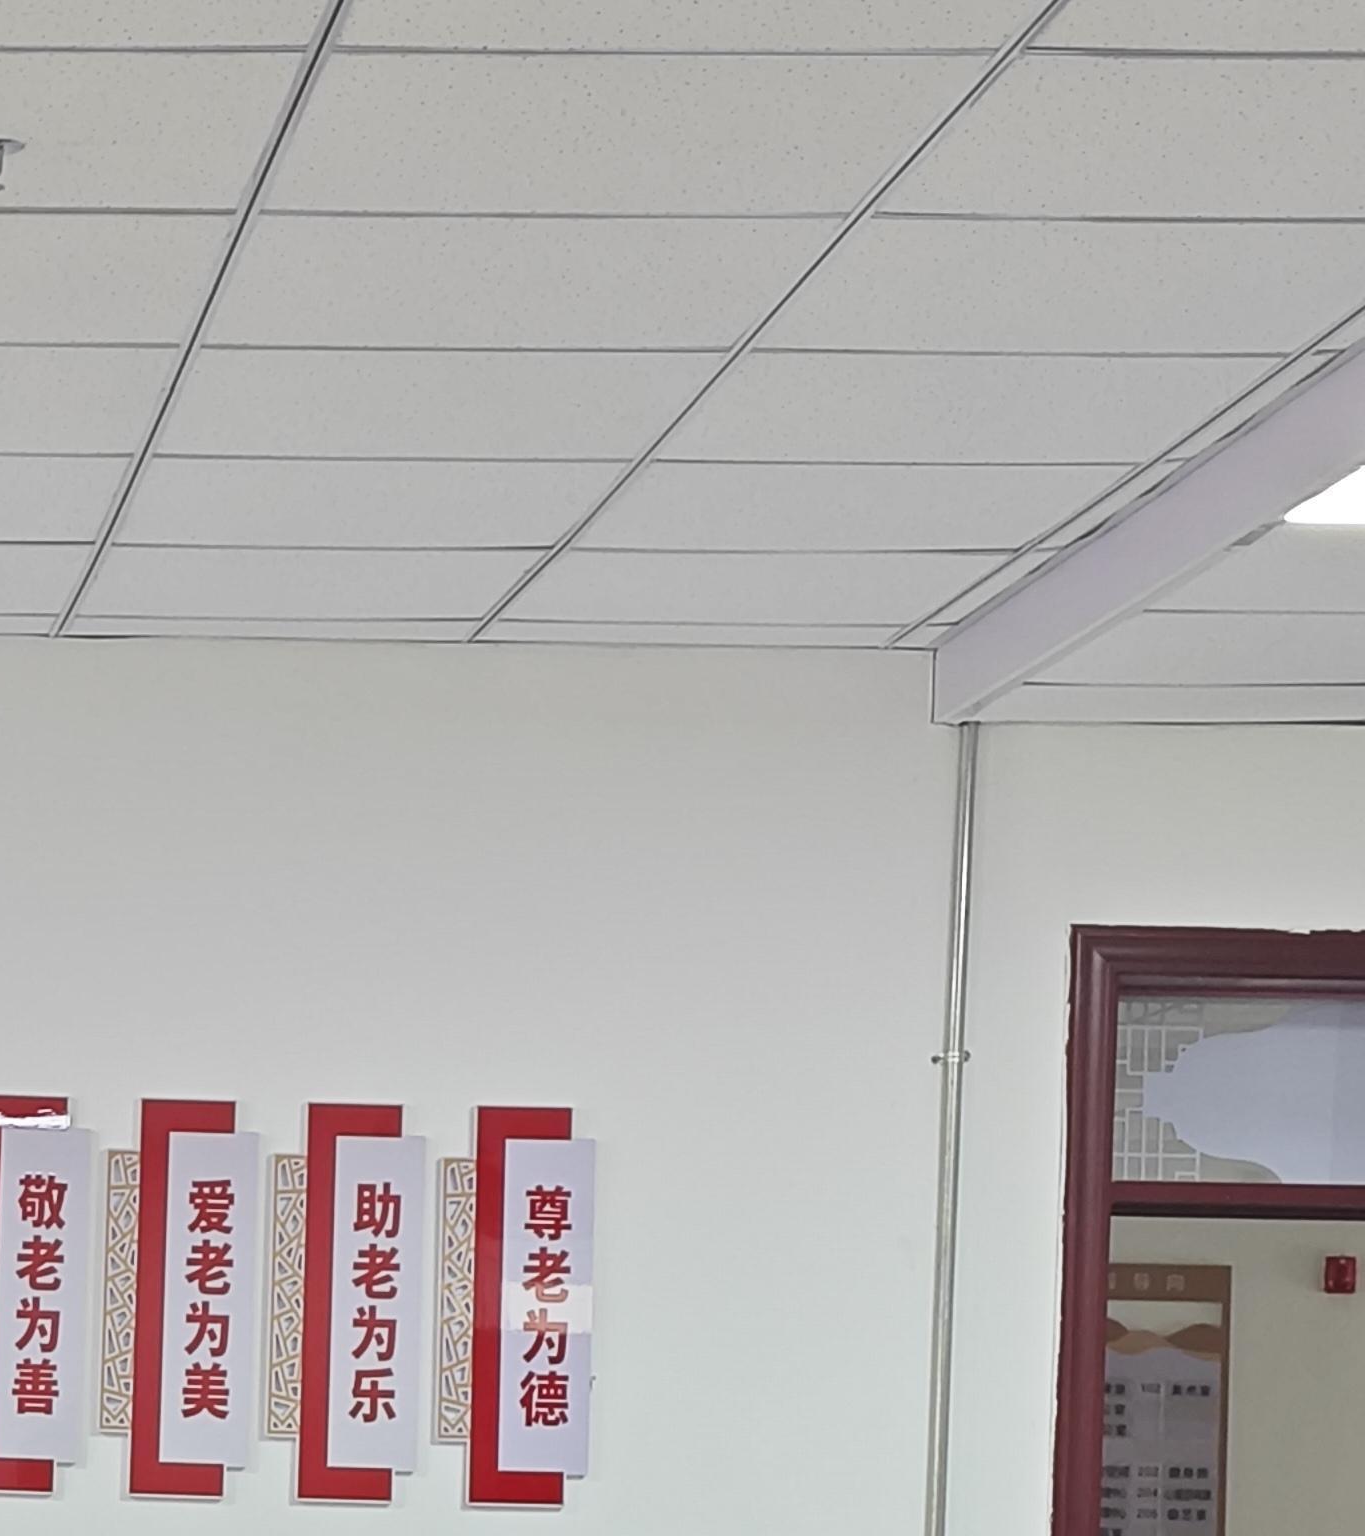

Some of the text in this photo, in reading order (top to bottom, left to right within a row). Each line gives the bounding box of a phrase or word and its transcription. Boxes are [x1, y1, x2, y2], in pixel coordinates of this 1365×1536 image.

[11, 1174, 68, 1416] 敬老为善
[181, 1178, 235, 1421] 爱老为美
[348, 1182, 401, 1423] 助老为乐
[519, 1185, 573, 1427] 尊老为德
